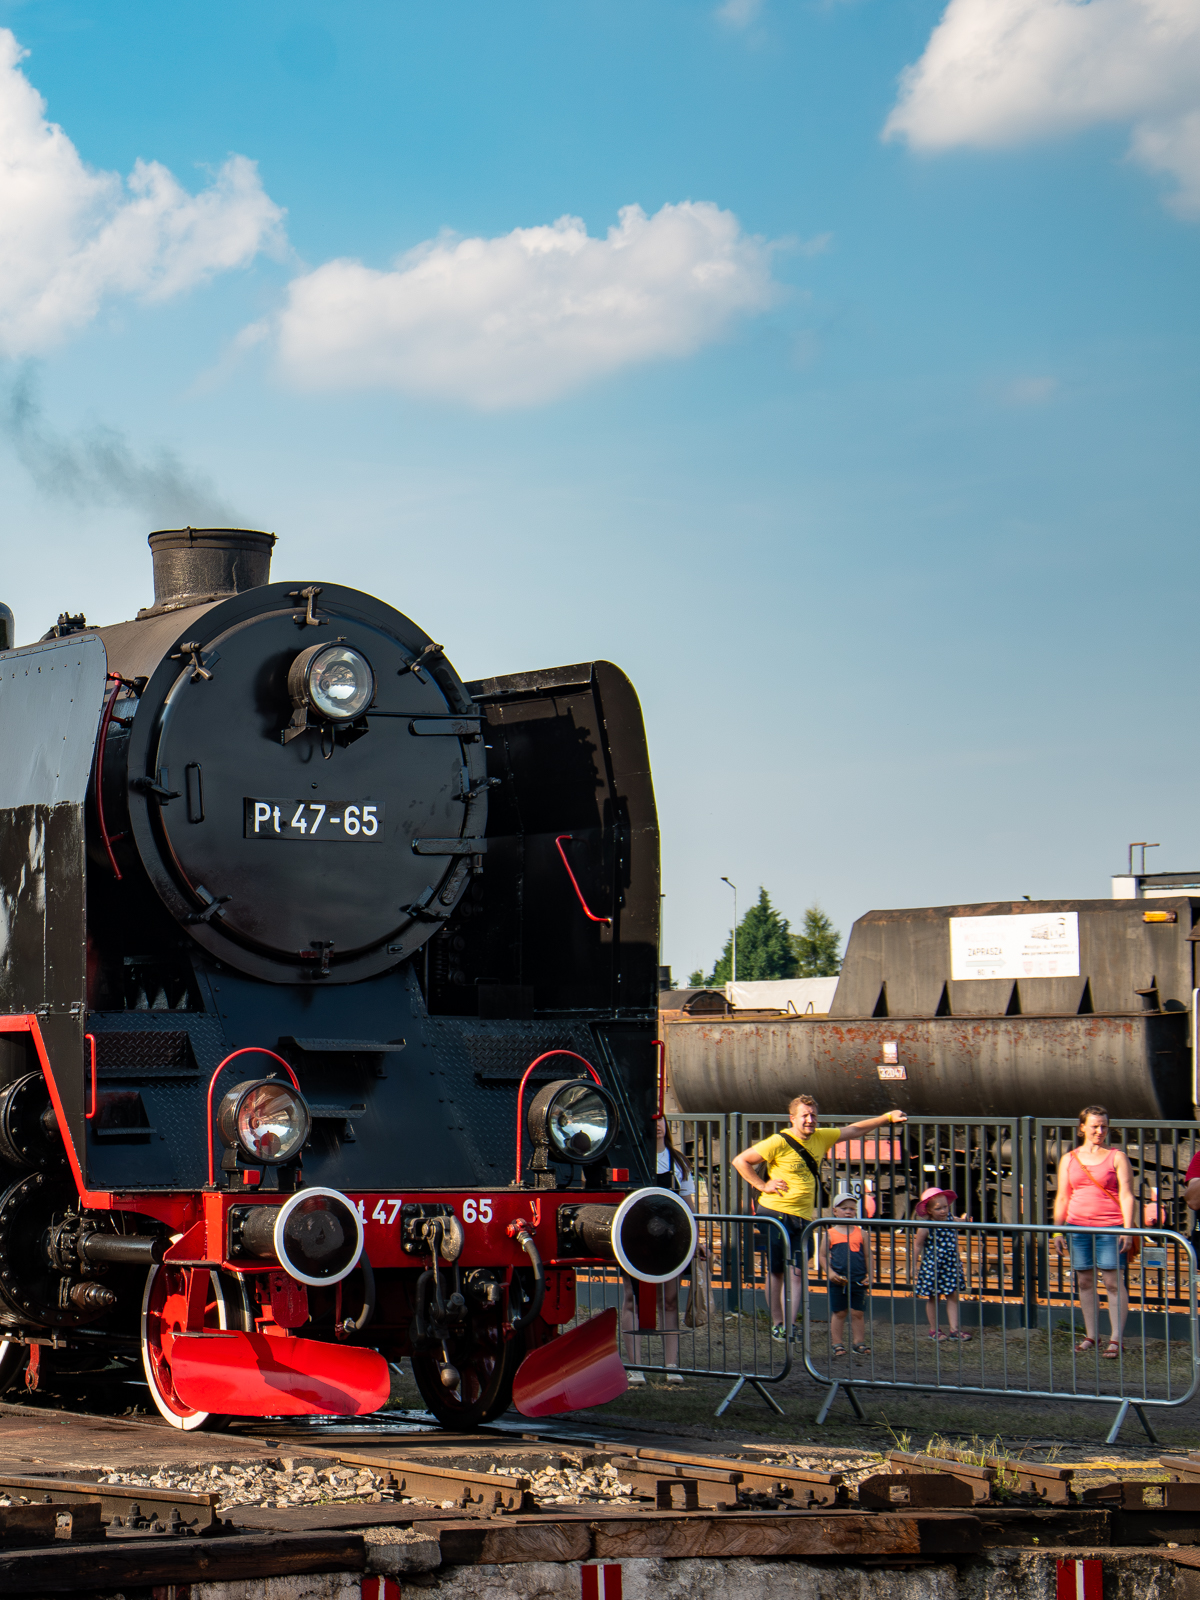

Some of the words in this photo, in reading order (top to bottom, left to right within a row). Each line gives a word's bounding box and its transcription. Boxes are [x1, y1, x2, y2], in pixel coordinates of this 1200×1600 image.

[254, 802, 281, 833] Pt
[291, 804, 378, 836] 47-65
[968, 946, 1003, 957] ZAPRASZA
[372, 1199, 402, 1224] 47
[462, 1198, 493, 1224] 65
